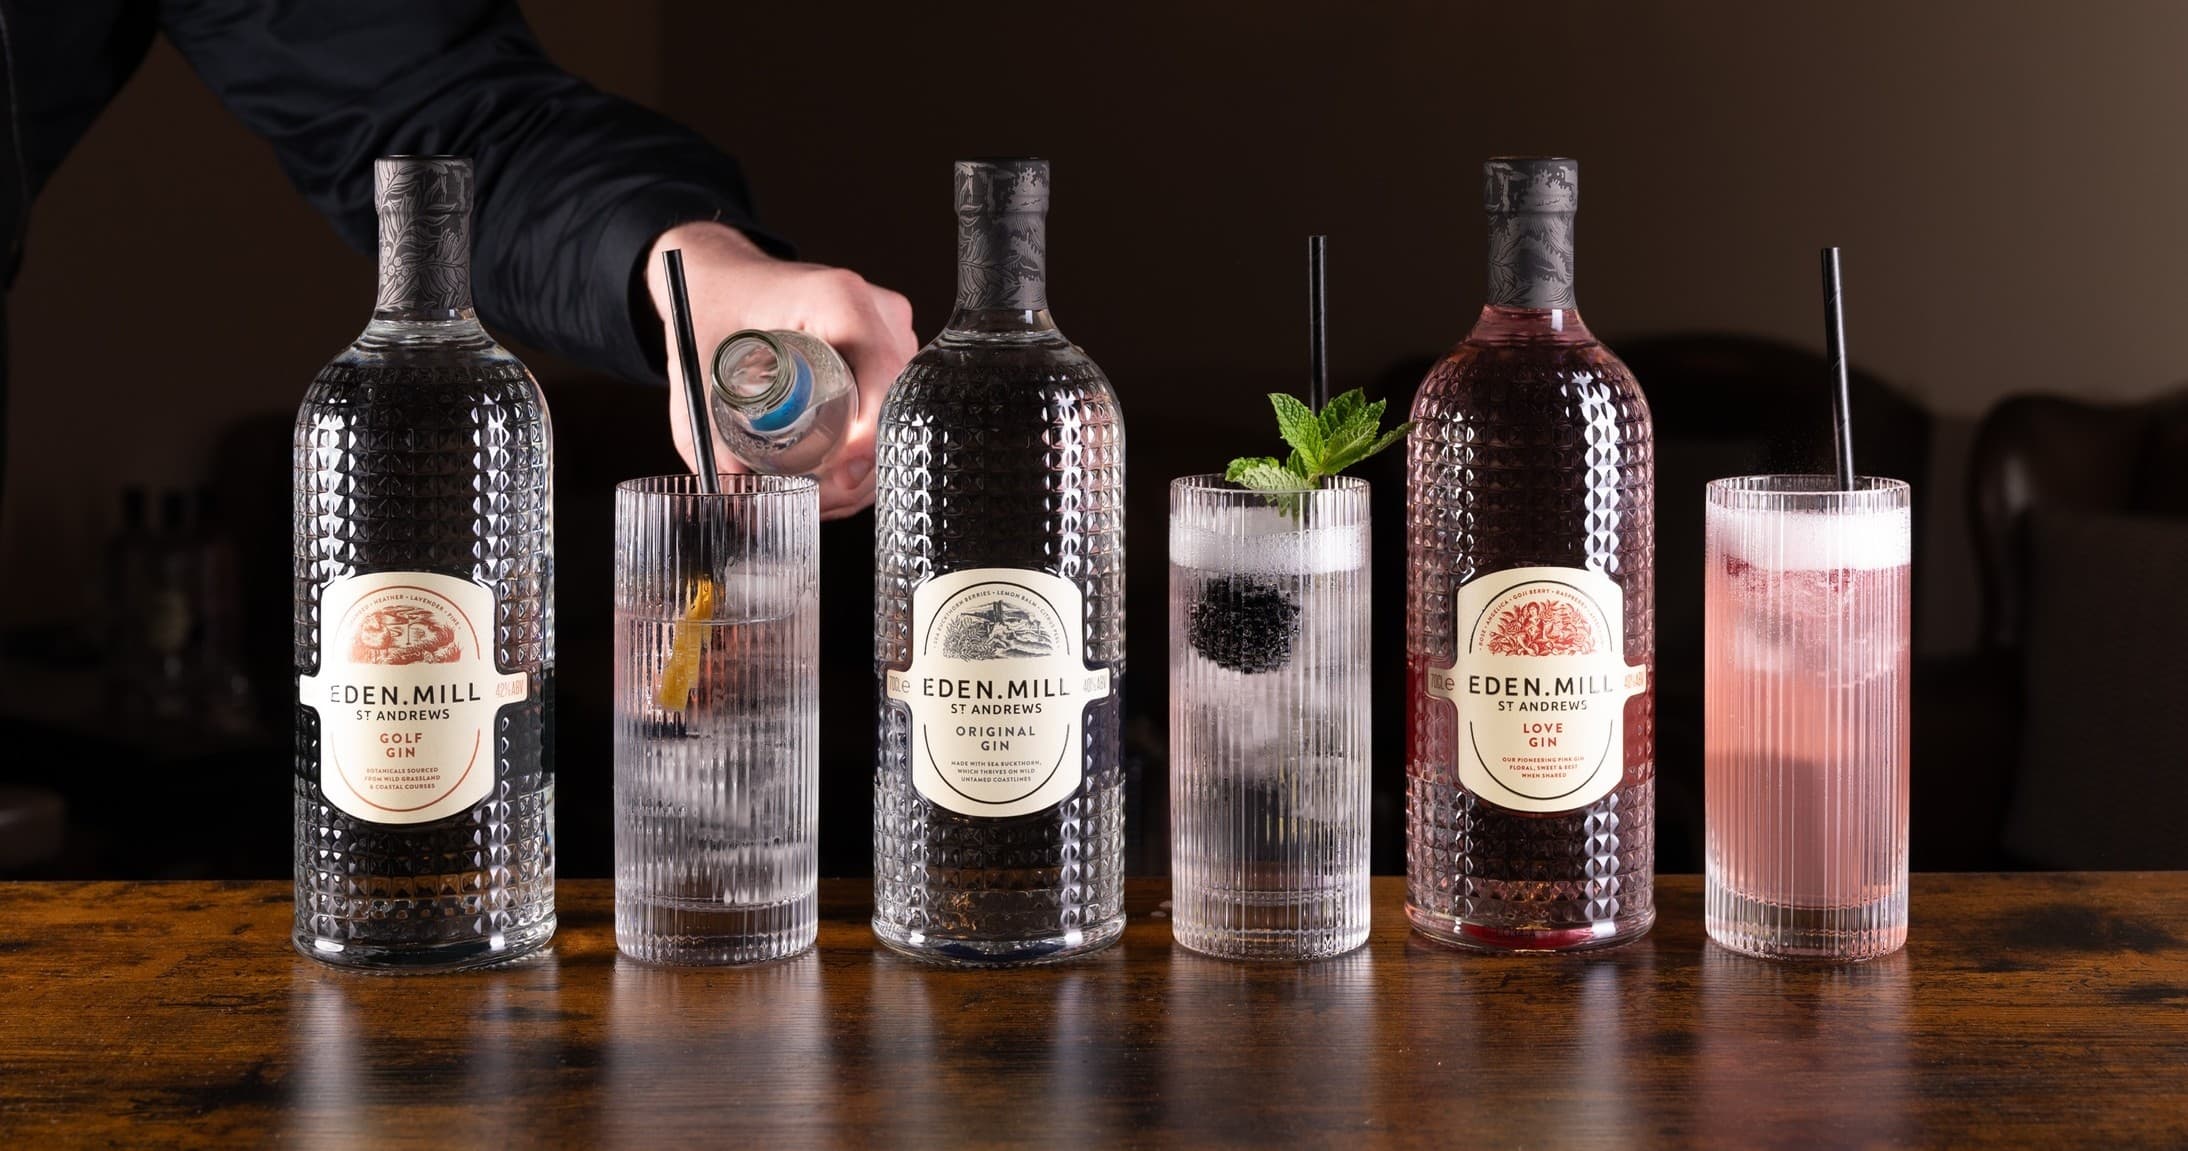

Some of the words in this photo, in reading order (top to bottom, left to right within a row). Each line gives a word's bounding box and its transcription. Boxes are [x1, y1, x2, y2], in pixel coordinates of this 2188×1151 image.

[374, 594, 404, 605] HEATHER
[410, 595, 444, 611] LAVENDER
[964, 590, 991, 604] BERRIES
[997, 590, 1020, 598] LEMON
[1021, 595, 1038, 609] BALM
[1486, 600, 1509, 625] ANGELICA
[1512, 591, 1528, 600] GOJI
[923, 677, 1071, 699] EDEN.MILL
[1469, 676, 1613, 697] EDEN.MILL
[330, 682, 481, 706] EDEN.MILL
[950, 703, 966, 714] ST
[971, 703, 1043, 715] ANDREWS
[1498, 701, 1514, 712] ST
[1519, 700, 1588, 712] ANDREWS
[356, 709, 371, 721] ST
[376, 708, 450, 721] ANDREWS
[955, 725, 1036, 737] ORIGINAL
[1523, 723, 1563, 734] LOVE
[379, 732, 423, 744] GOLF
[1529, 737, 1557, 748] GIN
[981, 740, 1010, 751] GIN
[386, 746, 416, 758] GIN
